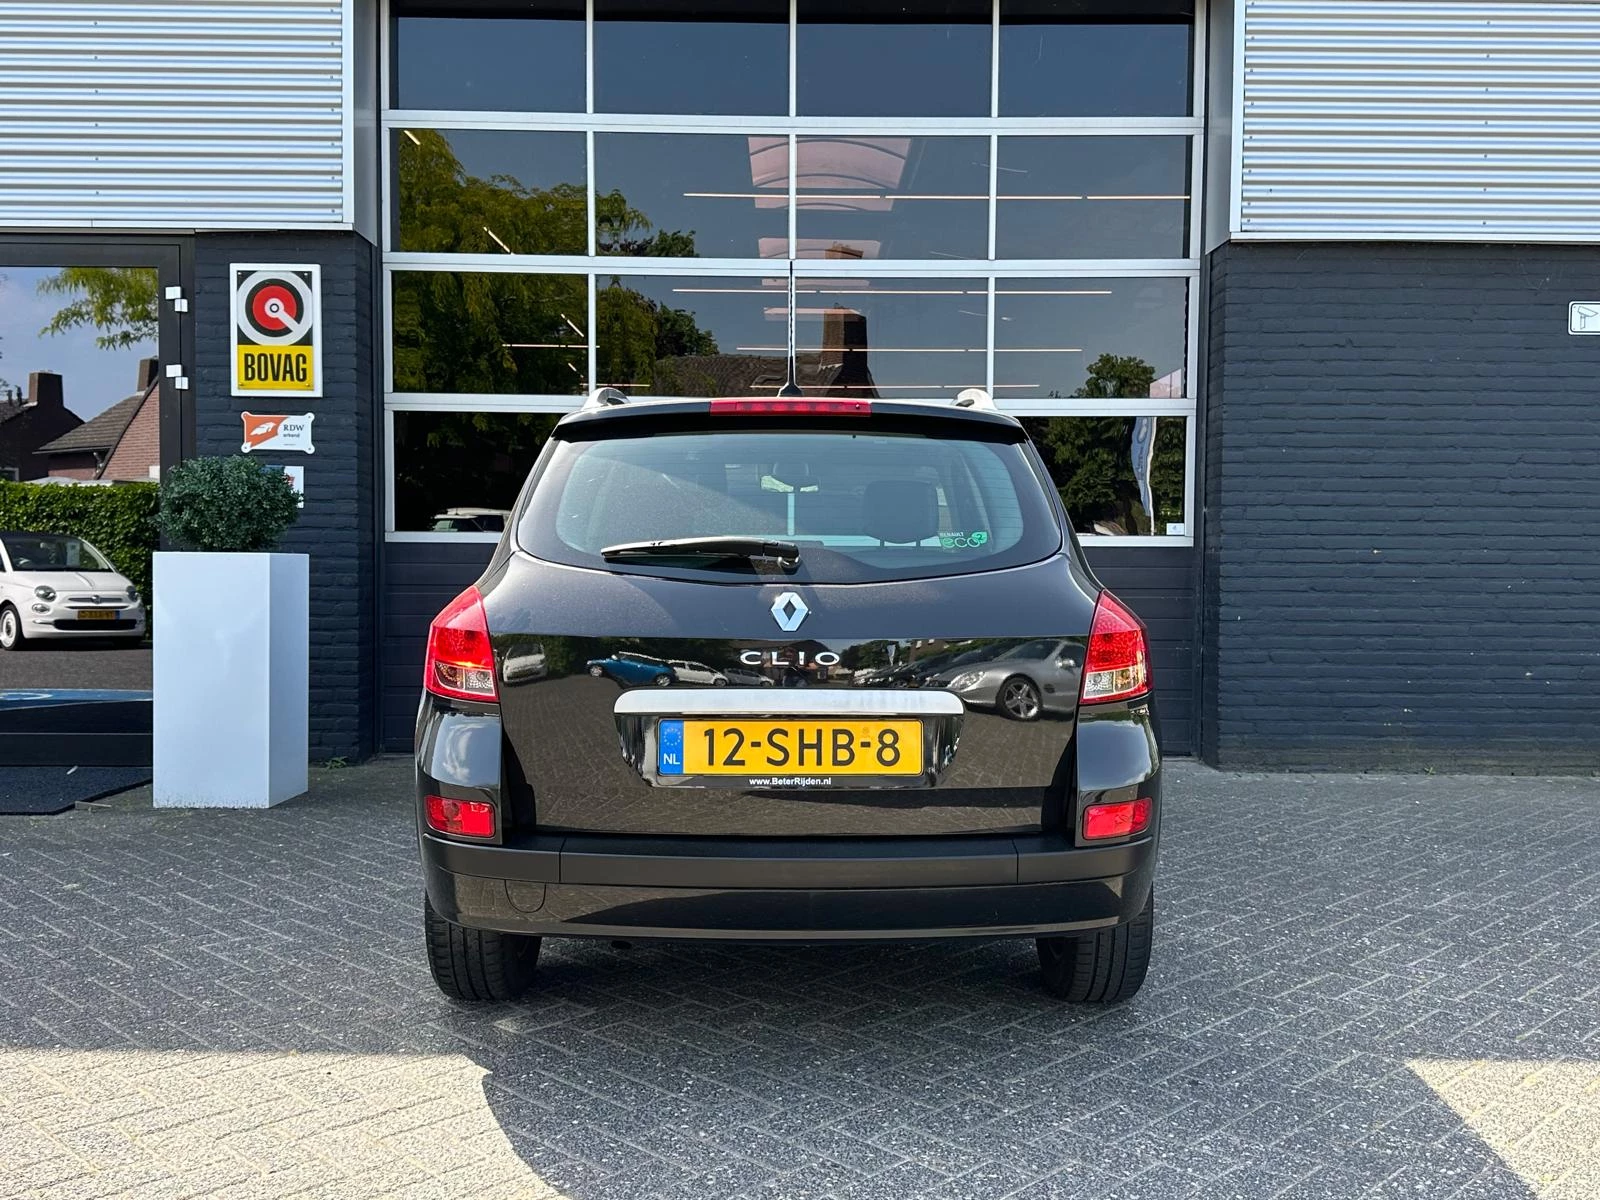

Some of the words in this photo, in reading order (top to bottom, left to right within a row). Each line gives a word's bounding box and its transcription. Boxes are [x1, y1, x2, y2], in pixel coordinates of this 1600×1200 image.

[244, 353, 307, 382] BOVAG
[740, 651, 840, 666] CLIO
[704, 728, 901, 767] 12-SHB-8
[663, 754, 680, 765] NL
[749, 777, 832, 787] www.BeterRijden.nl
